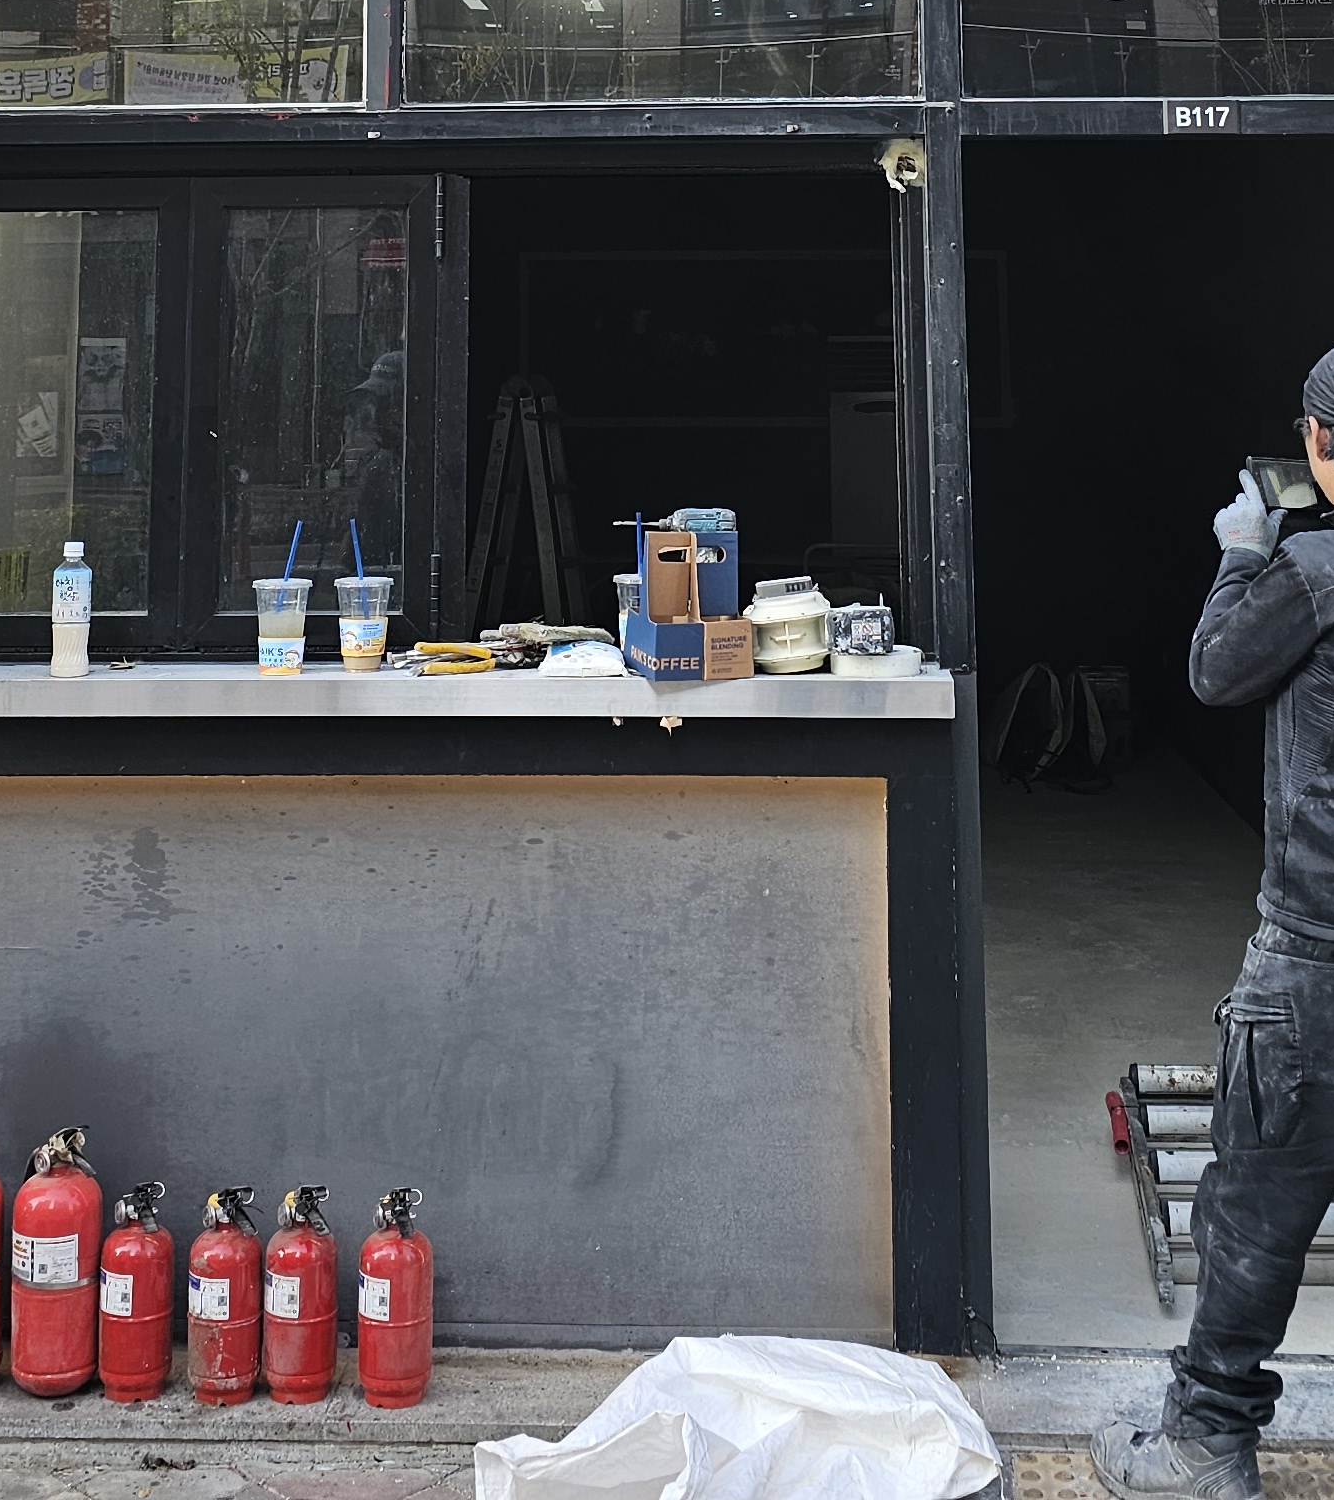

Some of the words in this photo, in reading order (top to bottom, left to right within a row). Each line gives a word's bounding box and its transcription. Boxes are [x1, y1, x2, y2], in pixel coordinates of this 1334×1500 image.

[1175, 106, 1230, 128] B117
[710, 635, 748, 644] SIGNATURE
[710, 642, 744, 651] BLENDING
[647, 655, 700, 671] COFFEE
